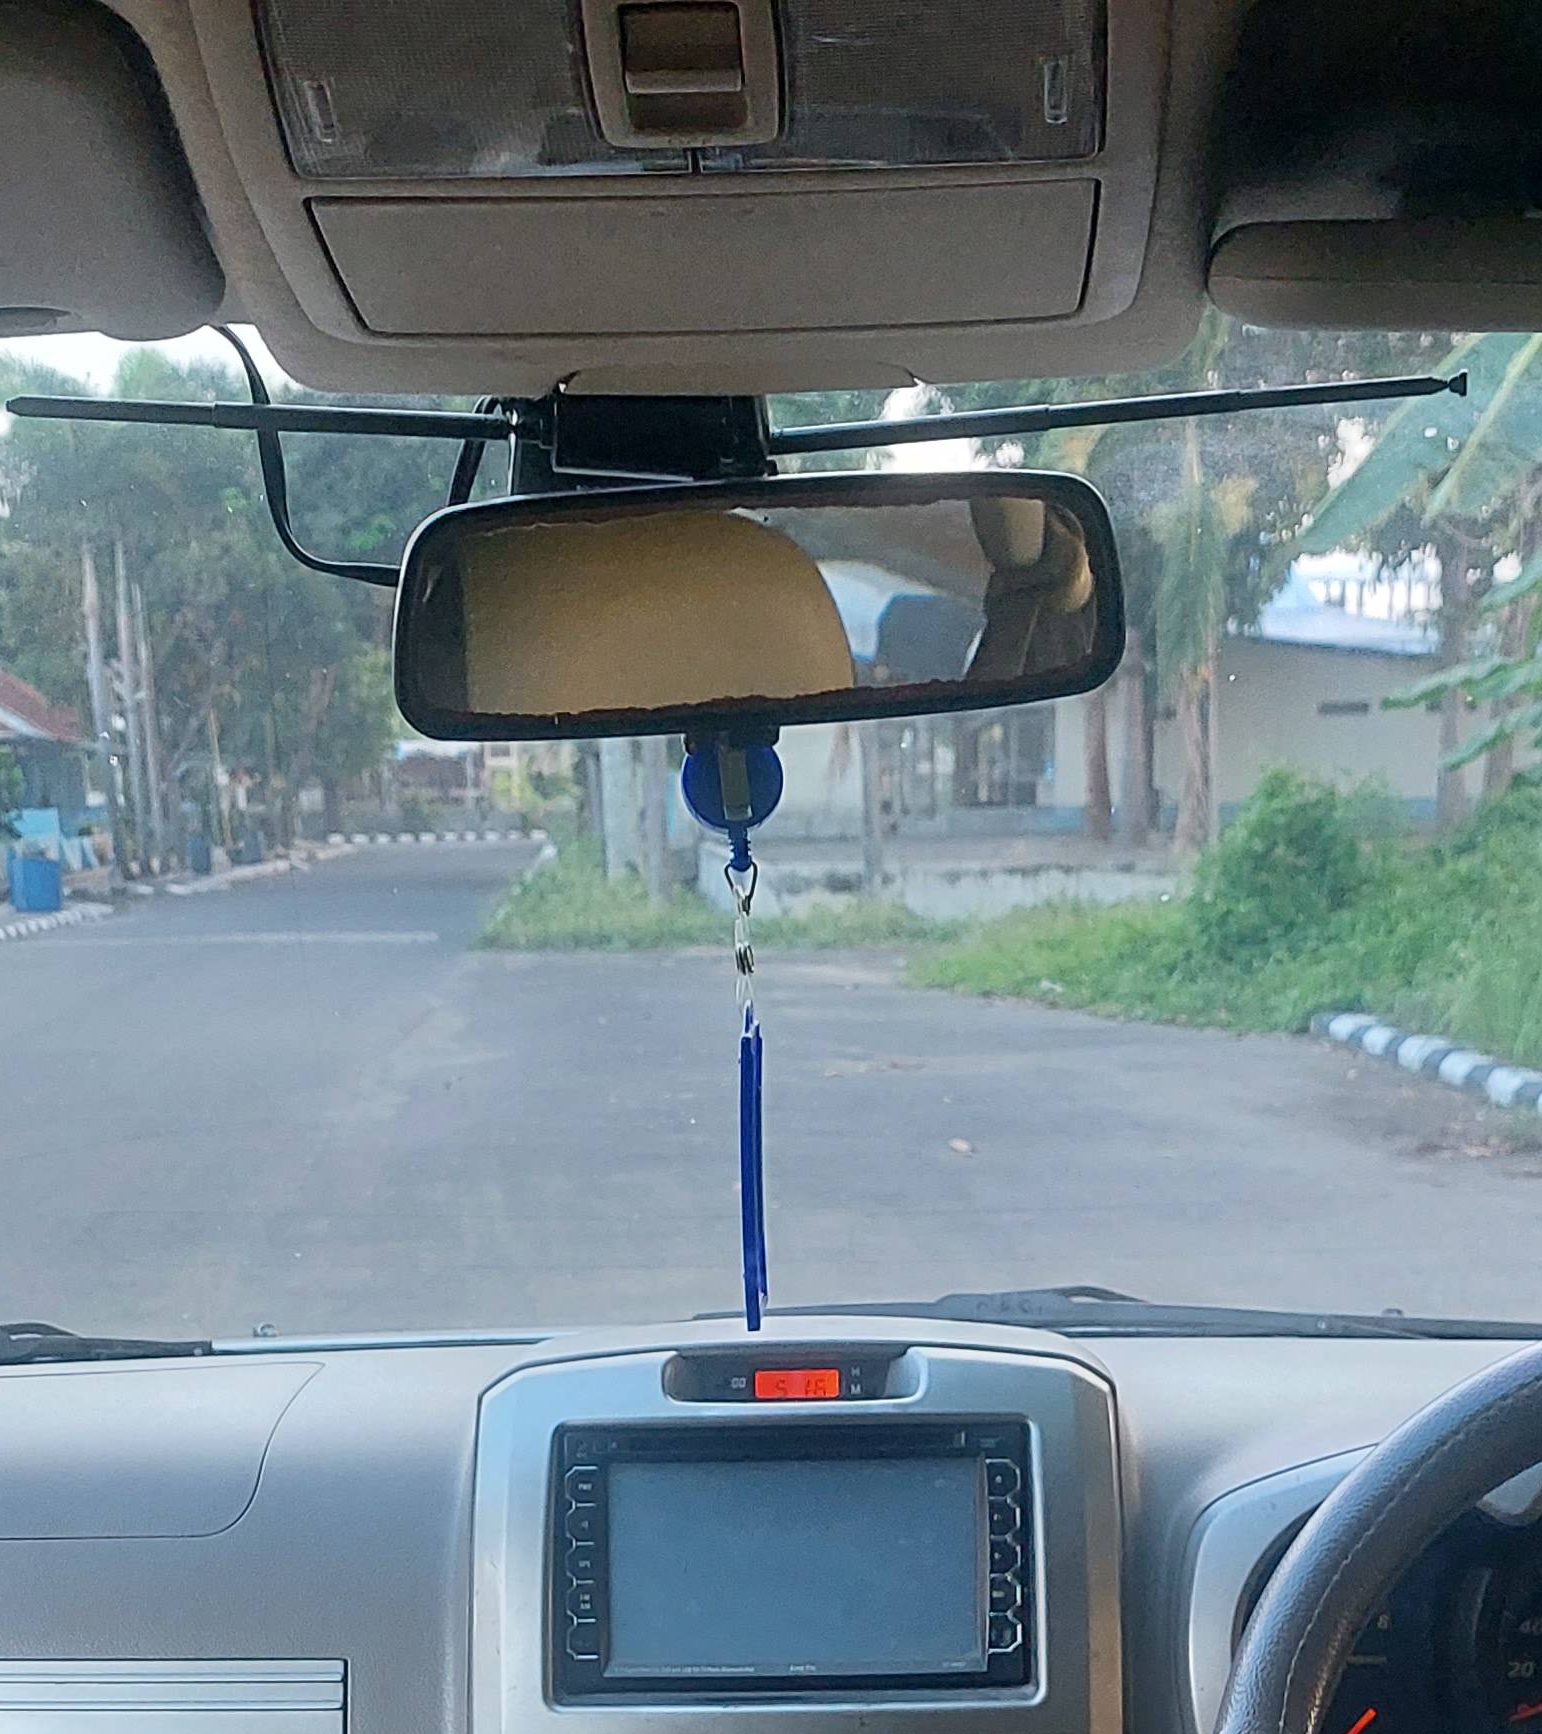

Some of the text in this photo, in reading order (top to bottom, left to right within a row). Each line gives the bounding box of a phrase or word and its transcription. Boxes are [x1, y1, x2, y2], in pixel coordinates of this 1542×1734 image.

[850, 1366, 861, 1377] H
[850, 1383, 862, 1395] M
[1507, 1661, 1537, 1679] 20
